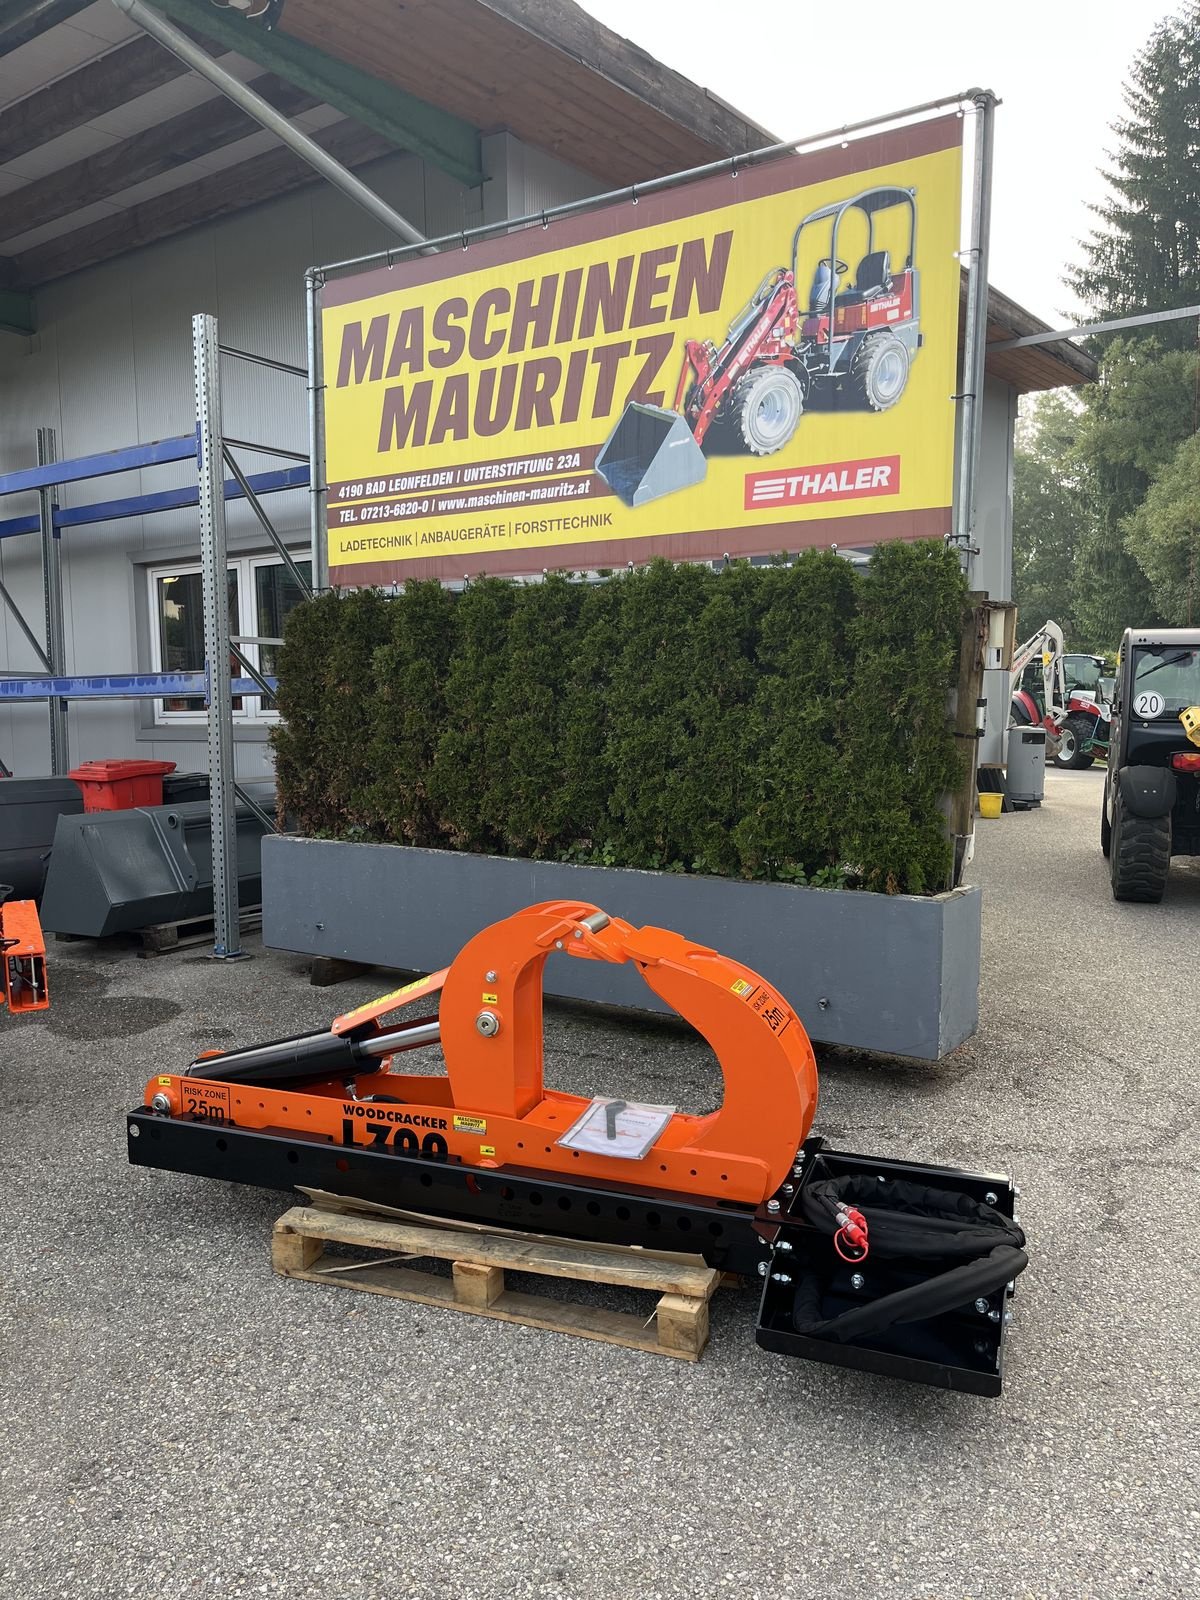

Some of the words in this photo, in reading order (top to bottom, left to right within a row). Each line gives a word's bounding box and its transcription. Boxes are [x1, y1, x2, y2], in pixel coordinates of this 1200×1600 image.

[336, 230, 733, 388] MASCHINEN
[377, 331, 675, 453] MAURITZ
[338, 484, 363, 498] 4190
[365, 480, 386, 495] BAD
[388, 471, 454, 492] LEONFELDEN
[463, 456, 554, 482] UNTERSTIFTUNG
[556, 453, 580, 470] 23A
[786, 465, 892, 497] THALER
[340, 509, 358, 523] TEL.
[360, 500, 429, 520] 07213-6820-0
[438, 479, 591, 511] www.maschinen-mauritz.at
[340, 534, 413, 553] LADETECHNIK
[420, 523, 506, 544] ANBAUGERÄTE
[514, 512, 613, 535] FORSTTECHNIK
[1139, 695, 1159, 714] 20
[761, 1007, 785, 1031] 25m
[184, 1086, 203, 1097] RISK
[204, 1089, 227, 1101] ZONE
[187, 1098, 225, 1121] 25m
[342, 1104, 449, 1131] WOODCRACKER
